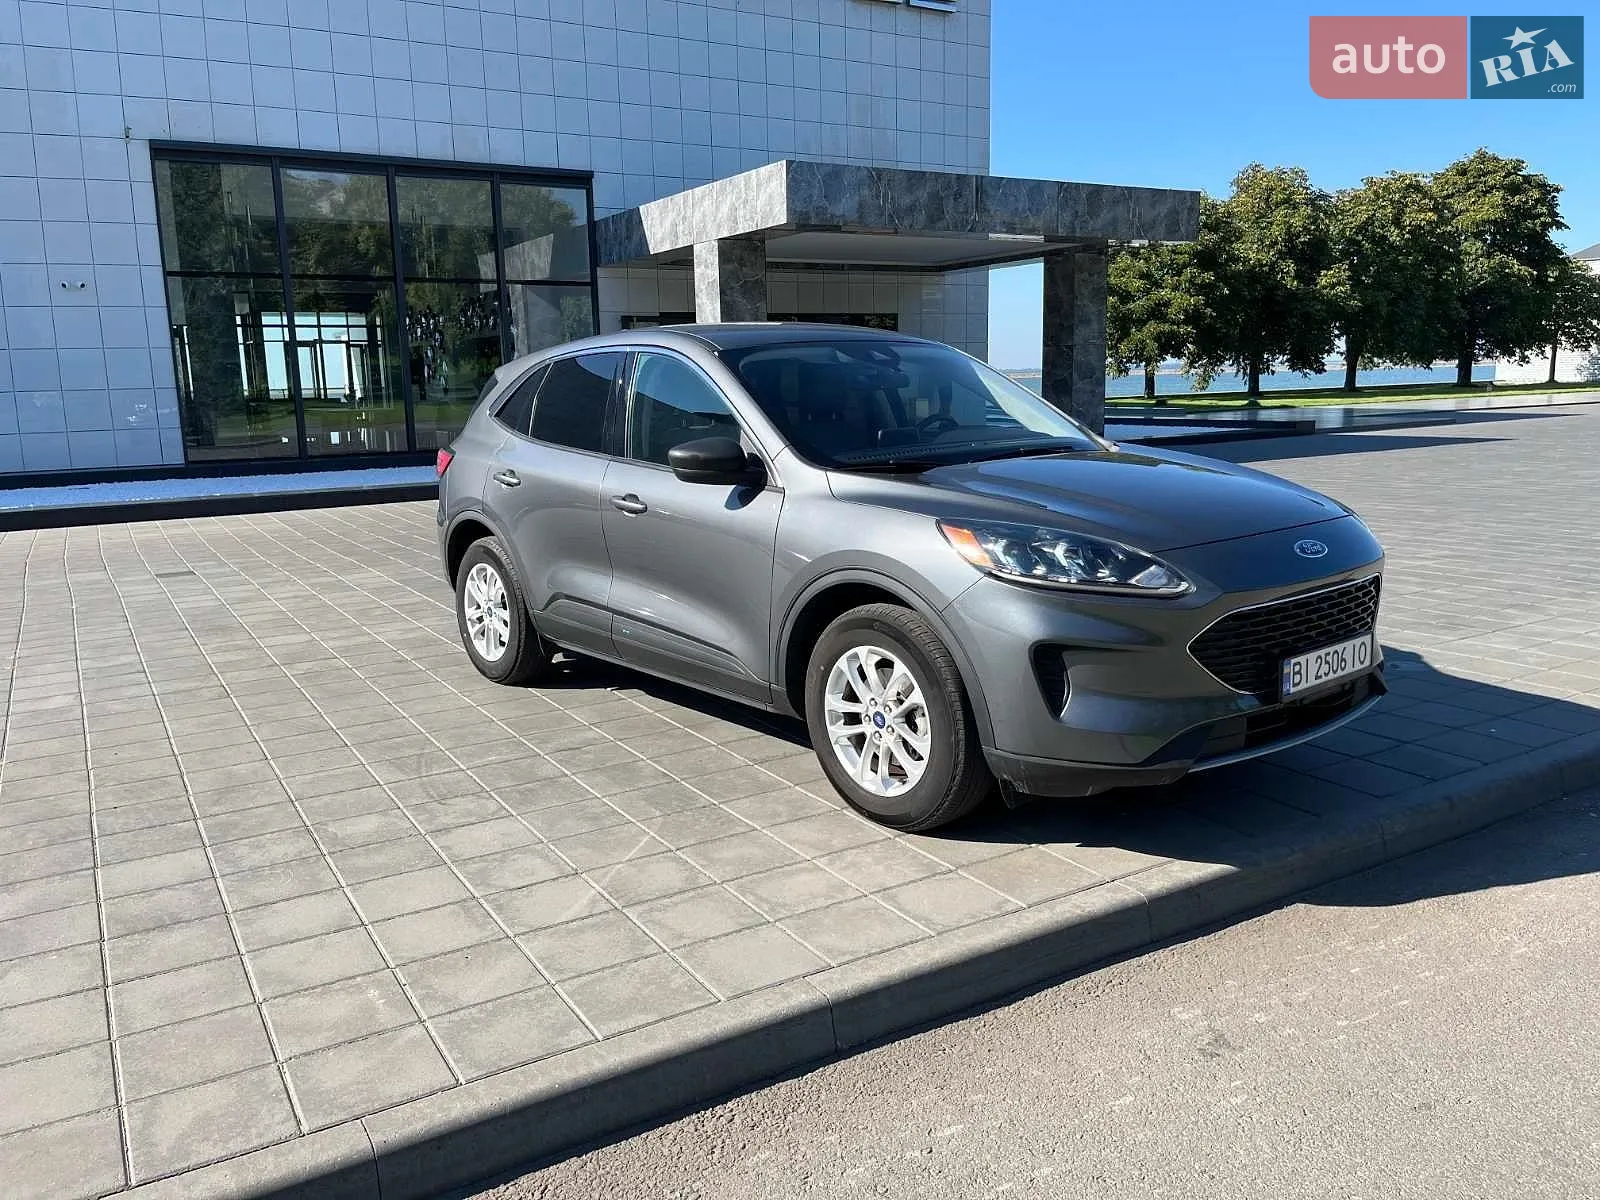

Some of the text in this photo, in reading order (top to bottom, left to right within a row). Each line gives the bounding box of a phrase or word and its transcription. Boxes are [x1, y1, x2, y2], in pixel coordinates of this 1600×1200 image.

[1292, 641, 1367, 688] BI 2506 IO
